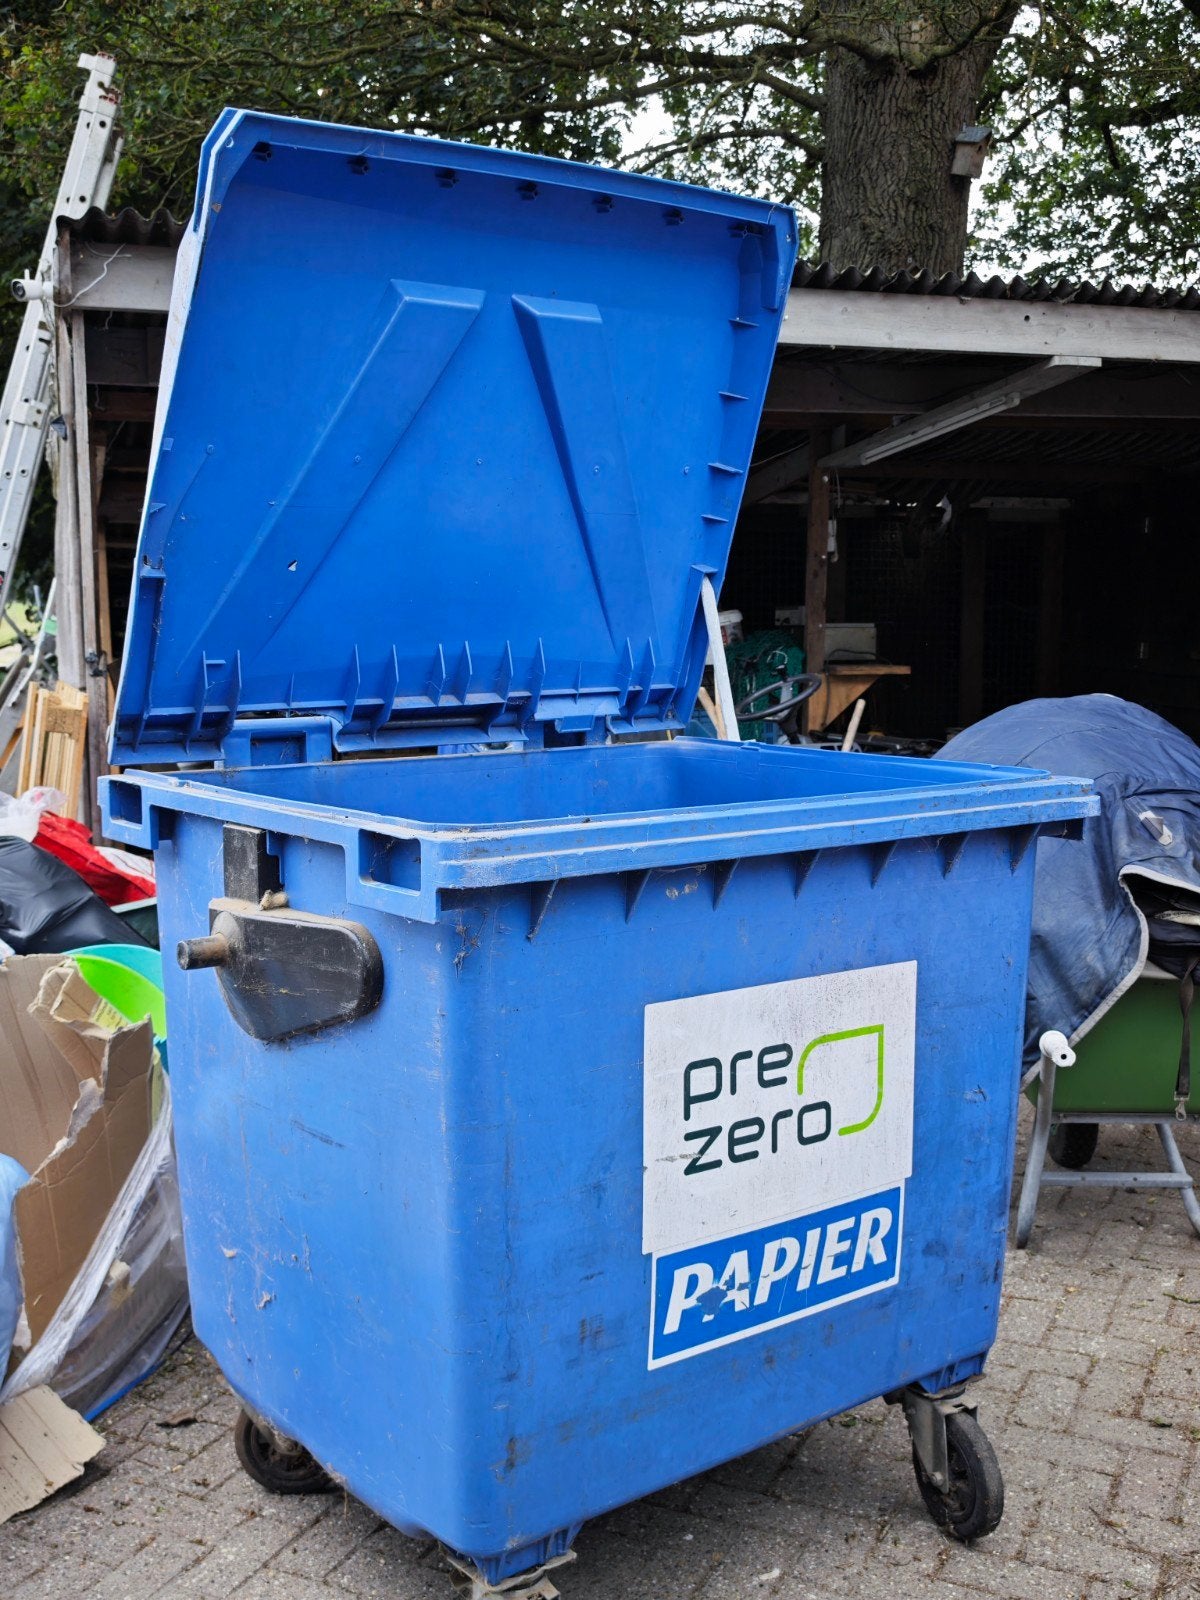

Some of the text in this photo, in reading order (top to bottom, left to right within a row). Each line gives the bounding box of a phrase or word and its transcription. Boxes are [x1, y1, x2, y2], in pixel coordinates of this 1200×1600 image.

[684, 1043, 793, 1121] pre
[684, 1101, 832, 1176] zero
[663, 1207, 893, 1336] PAPIER
